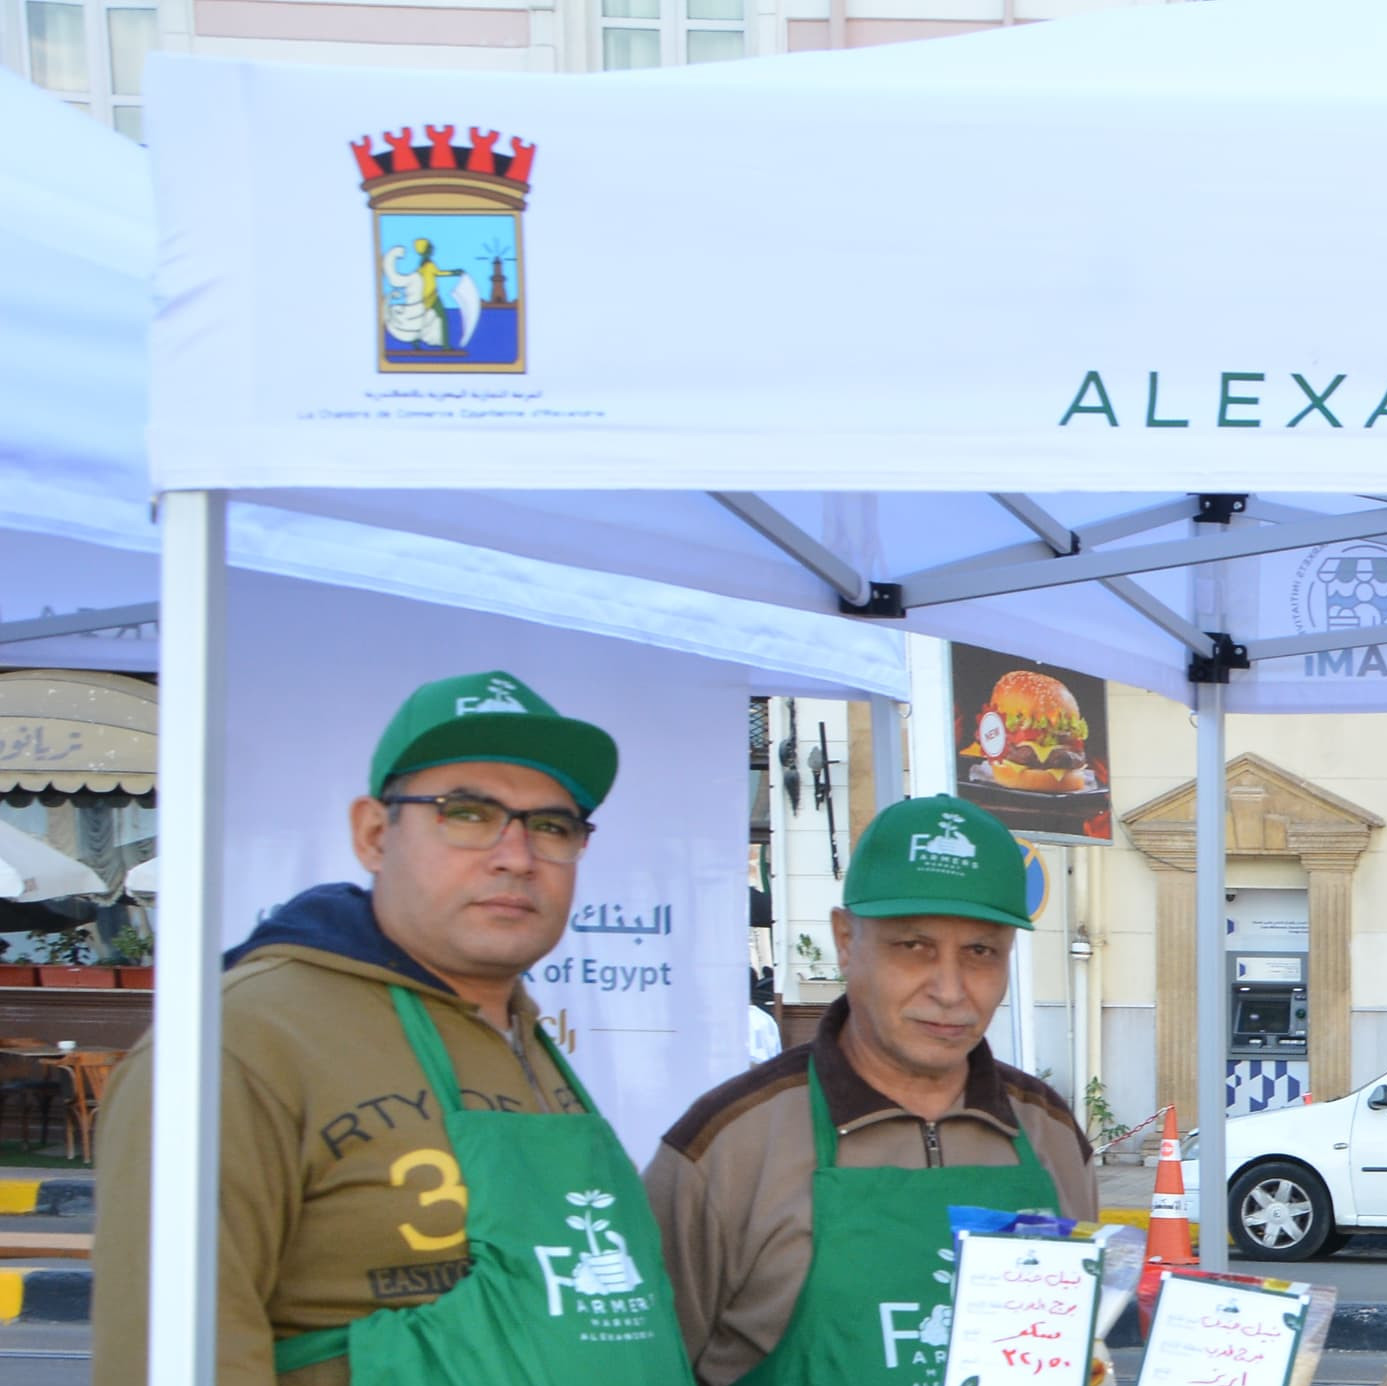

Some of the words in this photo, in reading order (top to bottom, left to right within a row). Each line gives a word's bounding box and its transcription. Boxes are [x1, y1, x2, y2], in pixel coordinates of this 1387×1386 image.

[0, 725, 83, 762] تريانو
[570, 903, 673, 946] البنك
[544, 957, 574, 984] of
[582, 958, 673, 993] Egypt
[390, 1148, 469, 1250] 3
